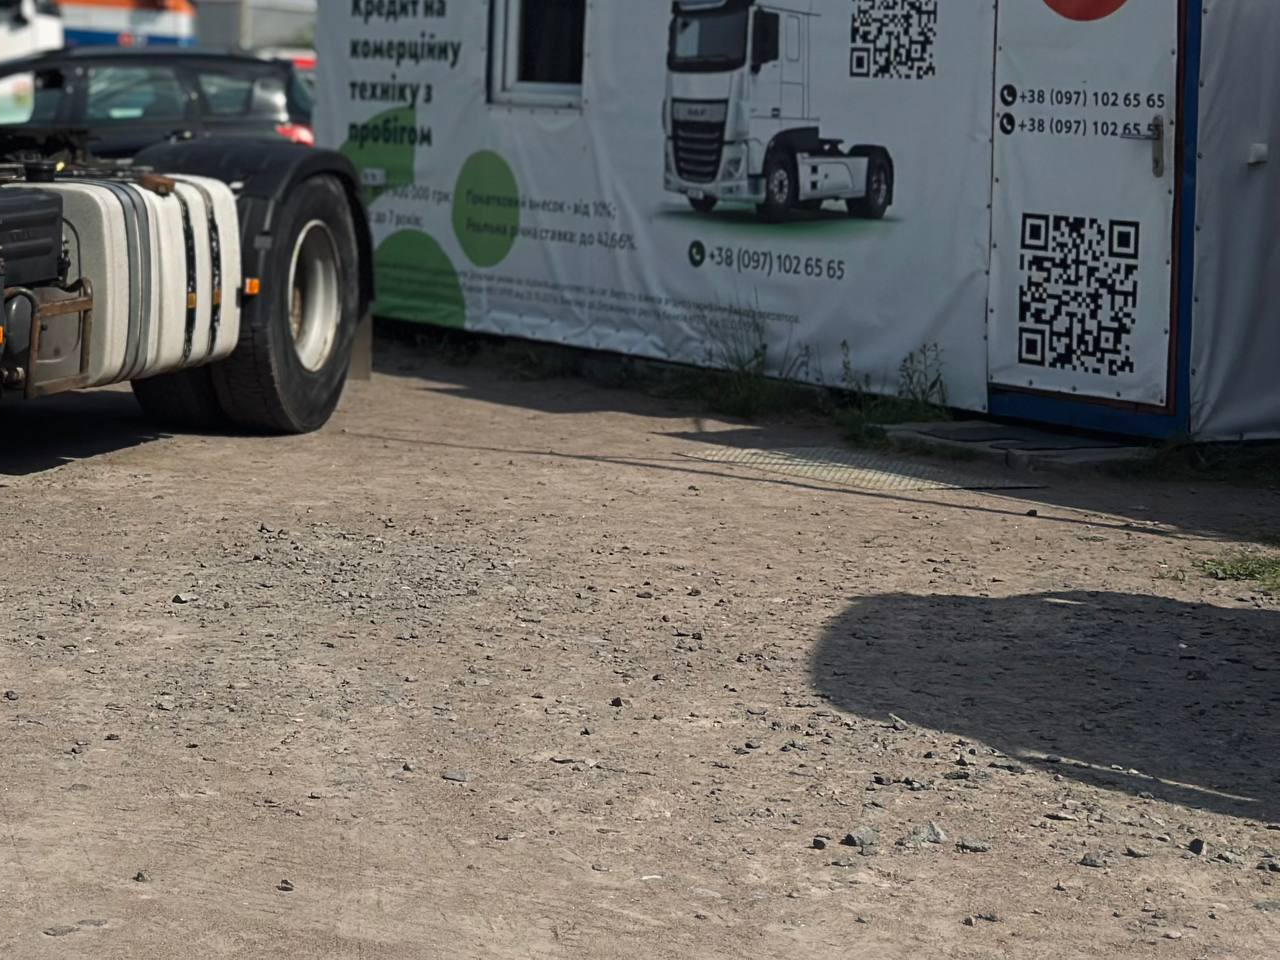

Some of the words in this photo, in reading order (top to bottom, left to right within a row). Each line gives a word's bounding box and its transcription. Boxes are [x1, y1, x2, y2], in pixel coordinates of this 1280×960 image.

[350, 30, 462, 68] комерційну
[349, 73, 418, 110] техніку
[423, 83, 433, 104] з
[1019, 89, 1045, 104] +38
[1050, 88, 1088, 108] (097)
[1094, 91, 1119, 107] 102
[1123, 93, 1141, 108] 65
[1146, 93, 1165, 109] 65
[348, 115, 433, 149] пробігом
[1018, 117, 1045, 133] +38
[1049, 117, 1088, 137] (097)
[1094, 121, 1119, 137] 102
[1123, 122, 1141, 136] 65
[709, 248, 734, 267] +38
[737, 248, 774, 277] (097)
[777, 253, 801, 275] 102
[804, 257, 823, 278] 65
[826, 260, 845, 280] 65
